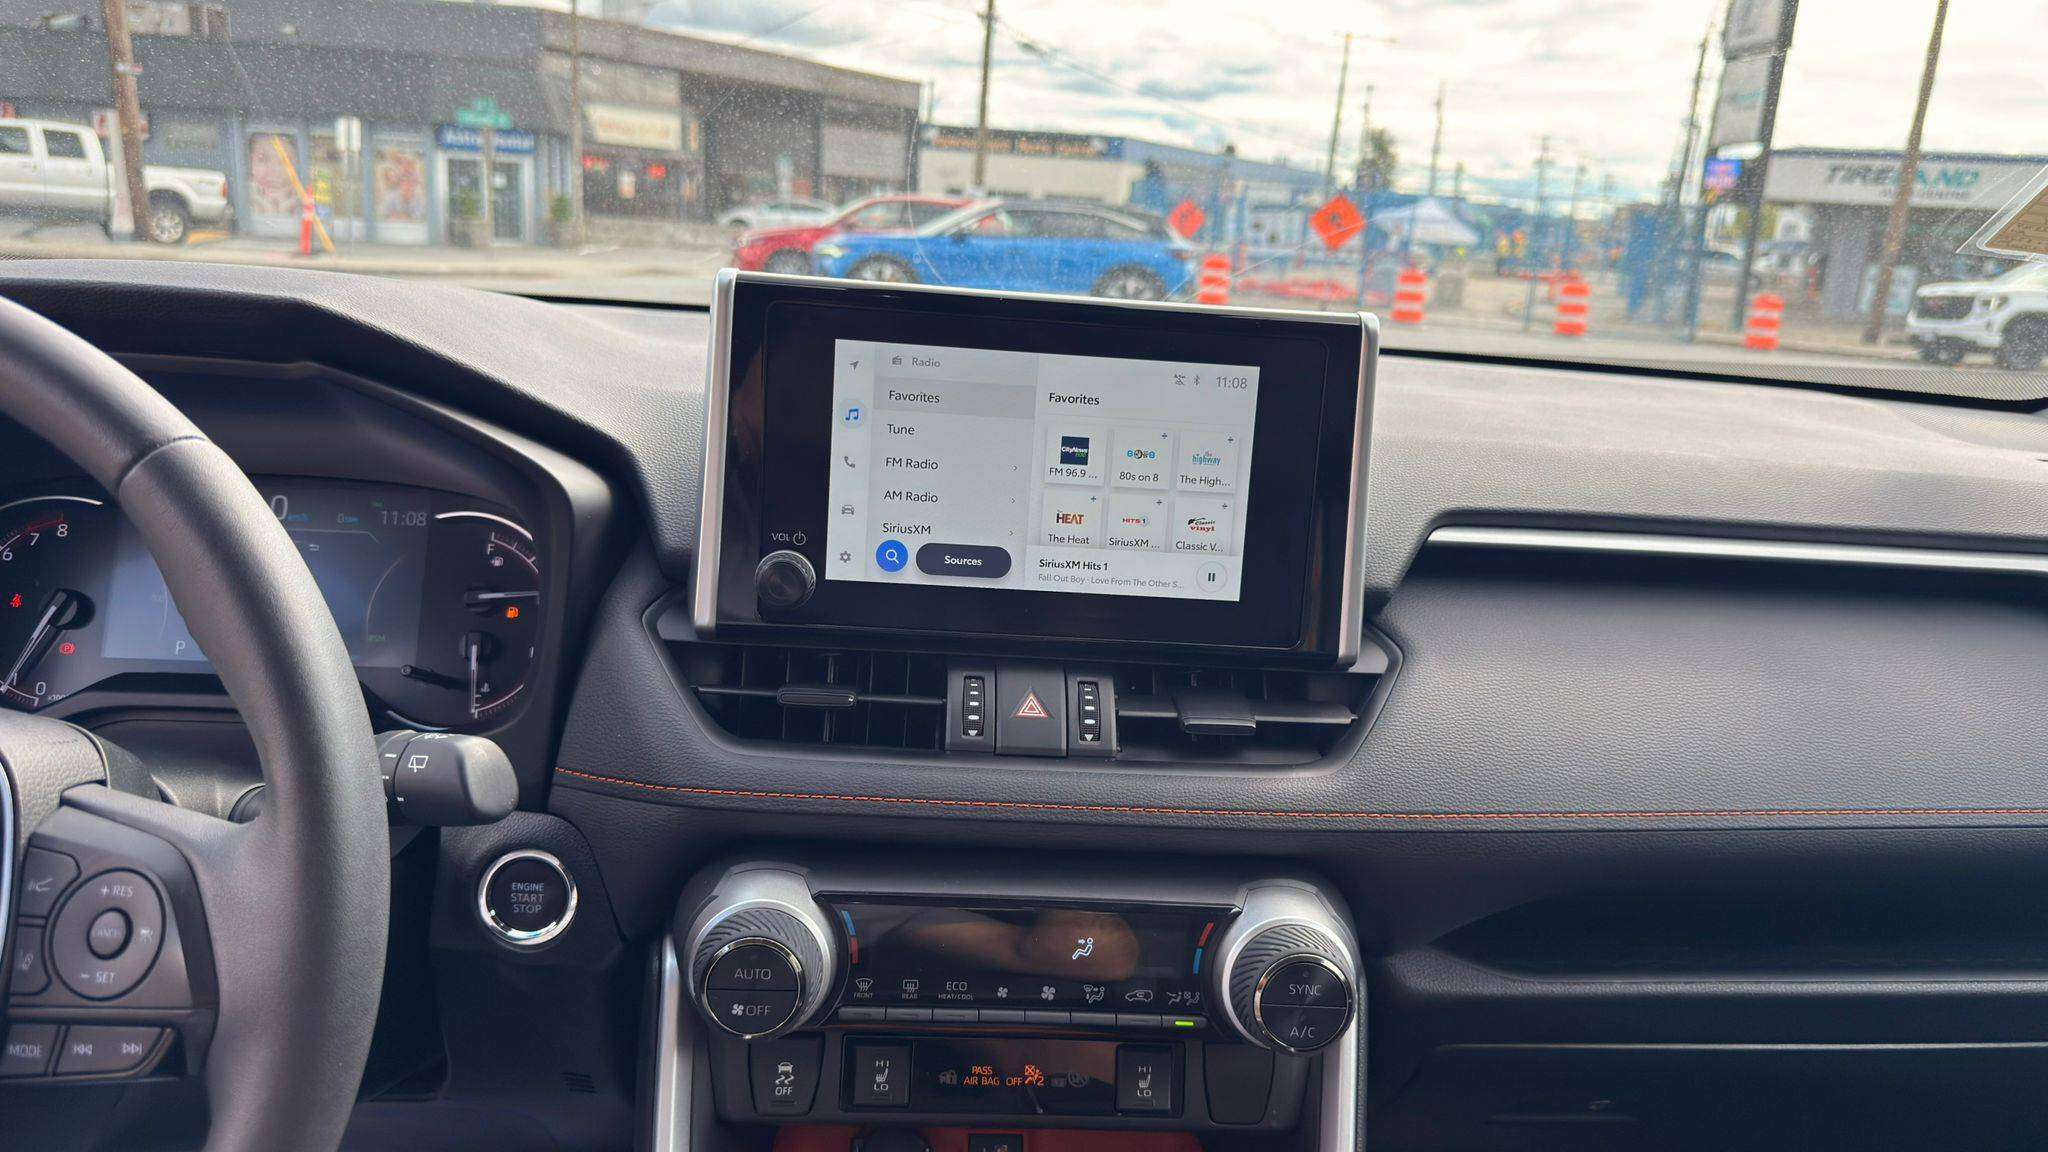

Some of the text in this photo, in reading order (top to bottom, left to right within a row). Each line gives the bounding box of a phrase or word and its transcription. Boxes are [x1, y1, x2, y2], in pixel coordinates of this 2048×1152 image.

[912, 357, 941, 368] Radio
[1216, 376, 1248, 389] 11:08
[888, 389, 940, 404] Favorites
[1049, 392, 1100, 406] Favorites
[887, 423, 915, 435] Tune
[886, 457, 939, 470] FM Radio
[1192, 453, 1221, 466] highway
[1049, 467, 1063, 477] FM
[1066, 468, 1087, 478] 96.9
[1119, 471, 1159, 482] 80s on 8
[1180, 474, 1198, 485] The
[884, 490, 938, 503] AM Radio
[381, 511, 427, 527] 11:08
[1056, 512, 1085, 525] HEAT
[57, 523, 69, 538] 8
[882, 522, 931, 535] SiriusXM
[30, 532, 40, 546] 7
[771, 532, 789, 541] VOL
[1048, 533, 1090, 545] The Heat
[1109, 537, 1149, 548] SiriusXM
[487, 543, 496, 555] F
[1175, 541, 1207, 551] Classic
[2, 548, 13, 561] 6
[944, 555, 982, 566] Sources
[1039, 559, 1108, 571] SiriusXM Hits 1
[1038, 573, 1052, 582] Fall
[1053, 574, 1068, 582] Out
[1070, 575, 1085, 585] Boy
[1091, 576, 1109, 585] Love
[1111, 577, 1131, 586] From
[1133, 578, 1147, 587] The
[1148, 579, 1171, 588] Other
[175, 640, 186, 655] P
[36, 681, 46, 696] 0
[112, 884, 134, 897] RES
[511, 882, 545, 892] ENGINE
[510, 892, 545, 902] START
[513, 903, 542, 914] STOP
[96, 971, 116, 984] SET
[734, 968, 772, 980] AUTO
[946, 981, 968, 991] ECO
[1288, 983, 1322, 996] SYNC
[938, 993, 974, 1001] HEAT/COOL
[746, 1005, 772, 1017] OFF
[1289, 1026, 1316, 1038] A/C
[9, 1044, 43, 1057] MODE
[971, 1065, 993, 1075] PASS
[1137, 1065, 1152, 1073] HI
[963, 1076, 1023, 1086] AIR BAG OFF
[774, 1086, 793, 1096] OFF
[1136, 1089, 1152, 1097] LO
